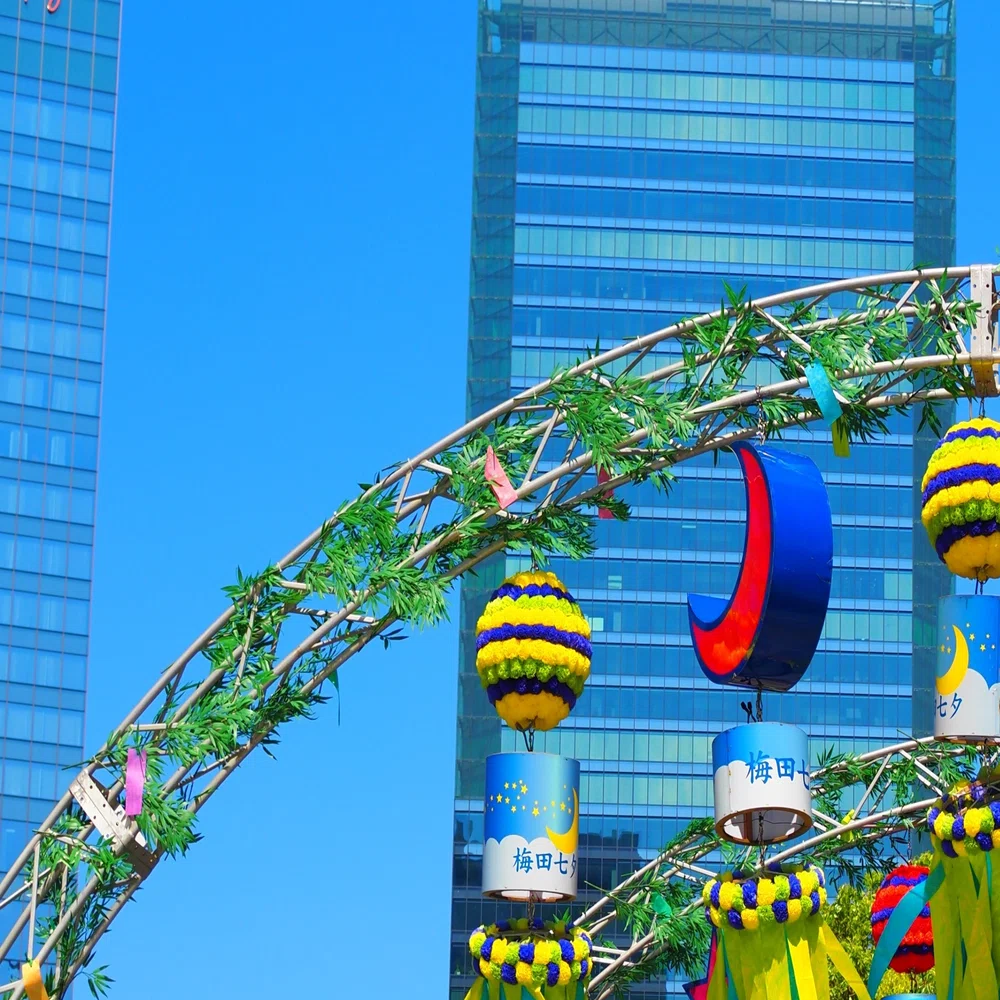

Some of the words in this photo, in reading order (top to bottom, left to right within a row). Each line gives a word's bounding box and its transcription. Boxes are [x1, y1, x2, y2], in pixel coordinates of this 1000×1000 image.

[934, 692, 963, 720] 七夕
[745, 750, 810, 791] 梅田七
[512, 846, 577, 878] 梅田七夕
